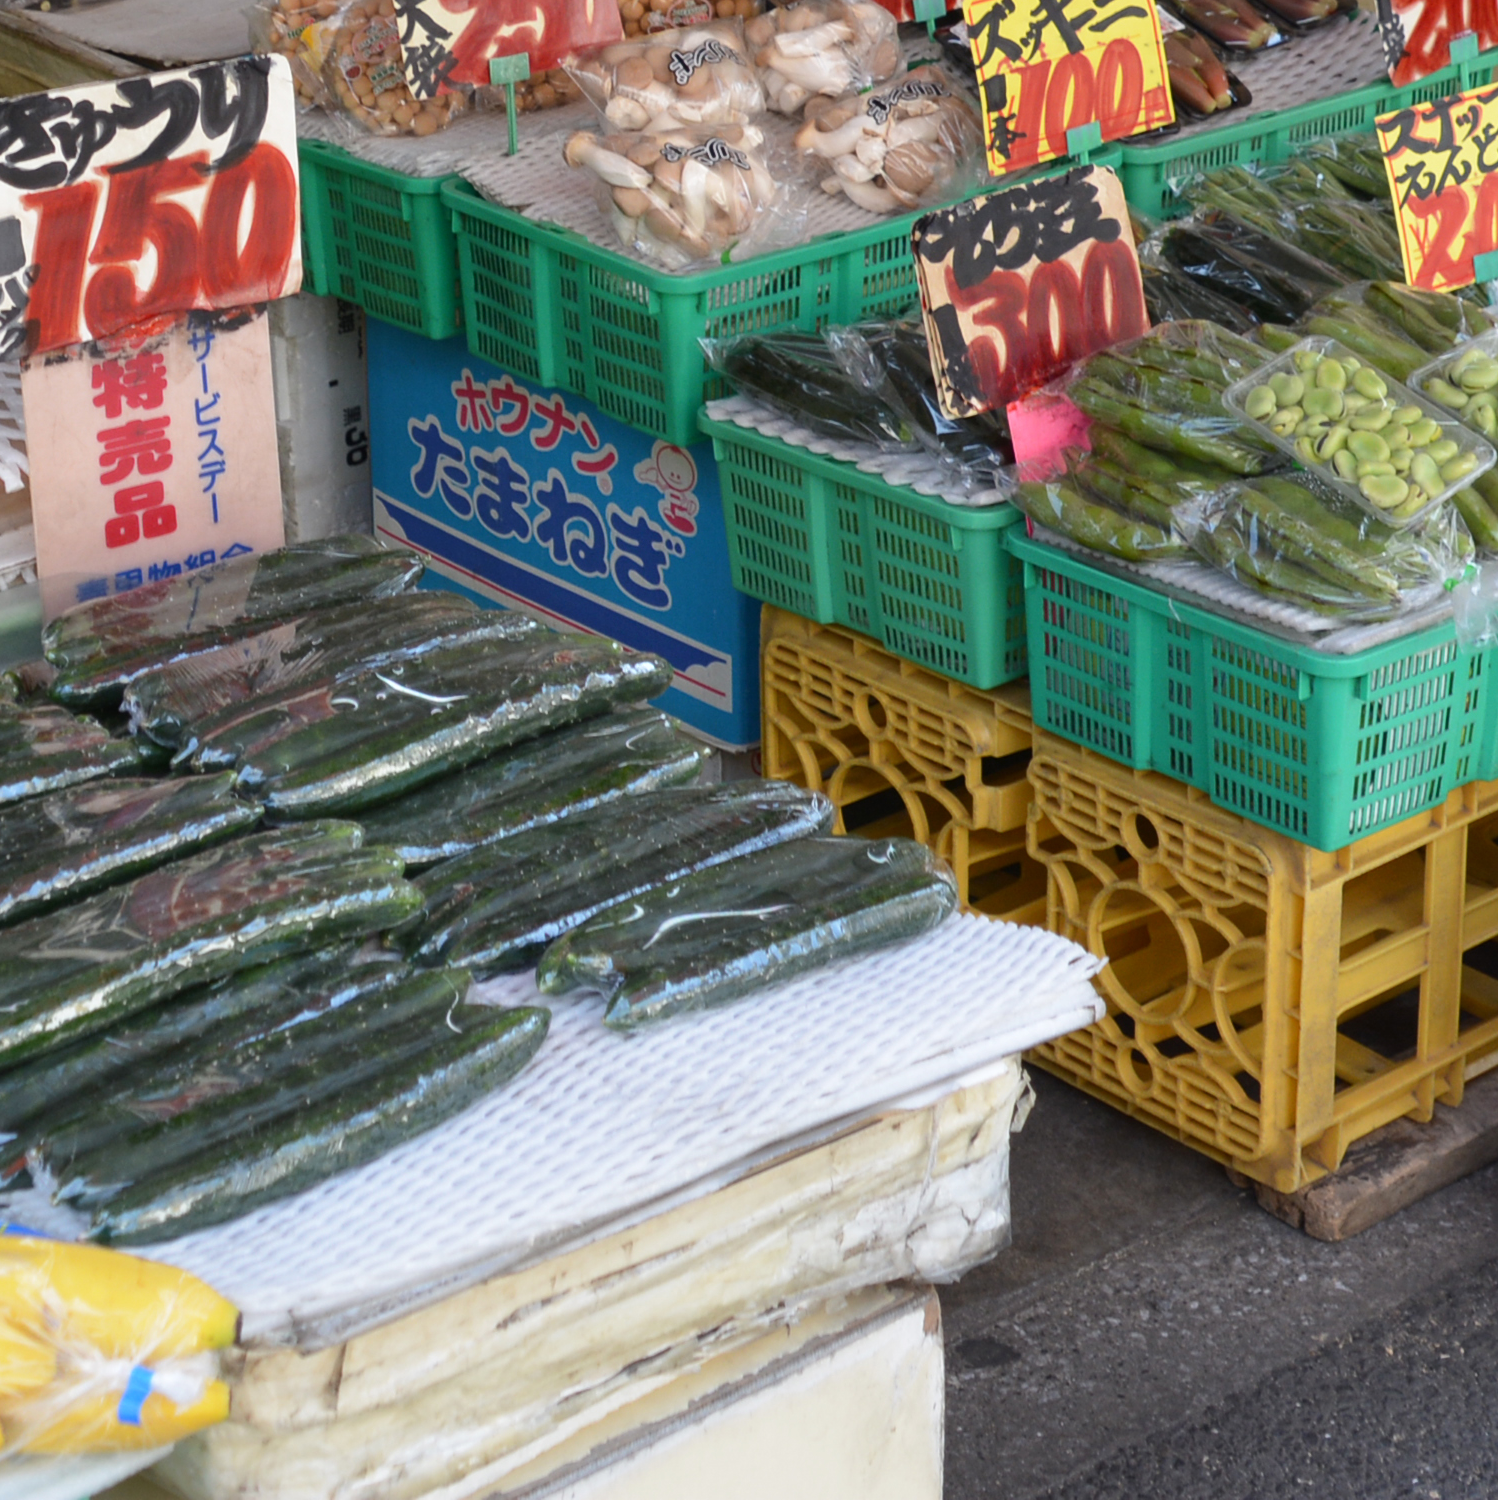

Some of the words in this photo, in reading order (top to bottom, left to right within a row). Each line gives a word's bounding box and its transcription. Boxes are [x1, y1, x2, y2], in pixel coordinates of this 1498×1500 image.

[995, 37, 1145, 172] 100
[19, 140, 299, 355] 150
[916, 168, 1123, 288] そら豆
[947, 236, 1147, 416] 300
[90, 352, 178, 550] 特売品
[408, 414, 686, 611] たまねぎ
[452, 368, 619, 480] ホウナン
